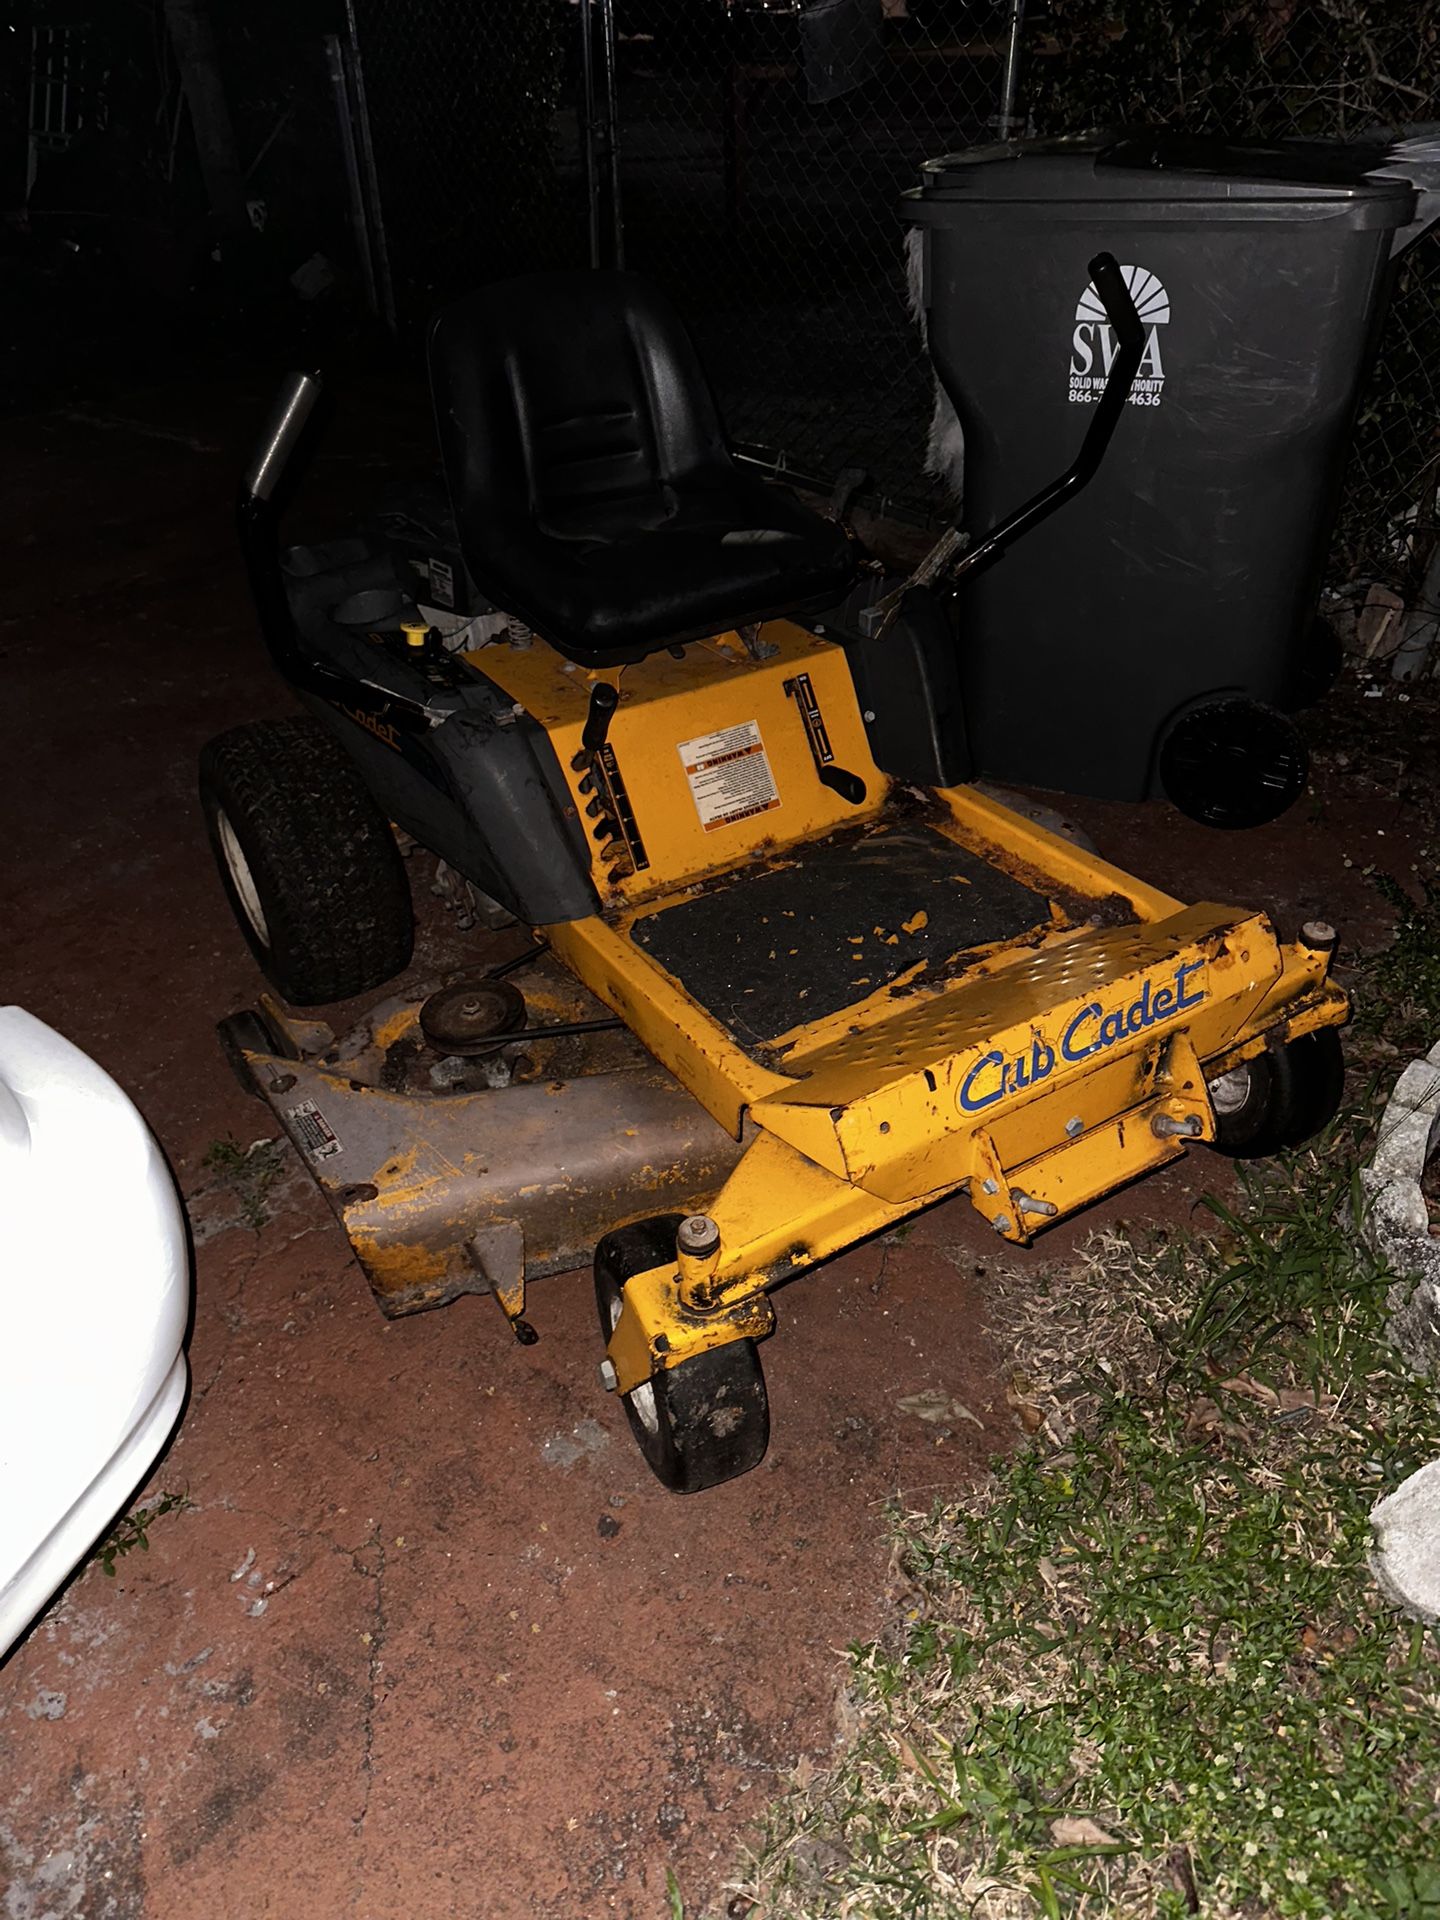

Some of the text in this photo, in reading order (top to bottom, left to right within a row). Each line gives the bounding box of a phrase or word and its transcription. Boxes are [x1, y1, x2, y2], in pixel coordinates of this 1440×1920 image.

[1069, 377, 1091, 389] SOLID
[1131, 379, 1164, 392] THORITY
[1068, 389, 1161, 406] 866-74636
[707, 751, 744, 767] WARNING
[725, 804, 762, 823] WARNING
[1062, 959, 1205, 1061] Cadet
